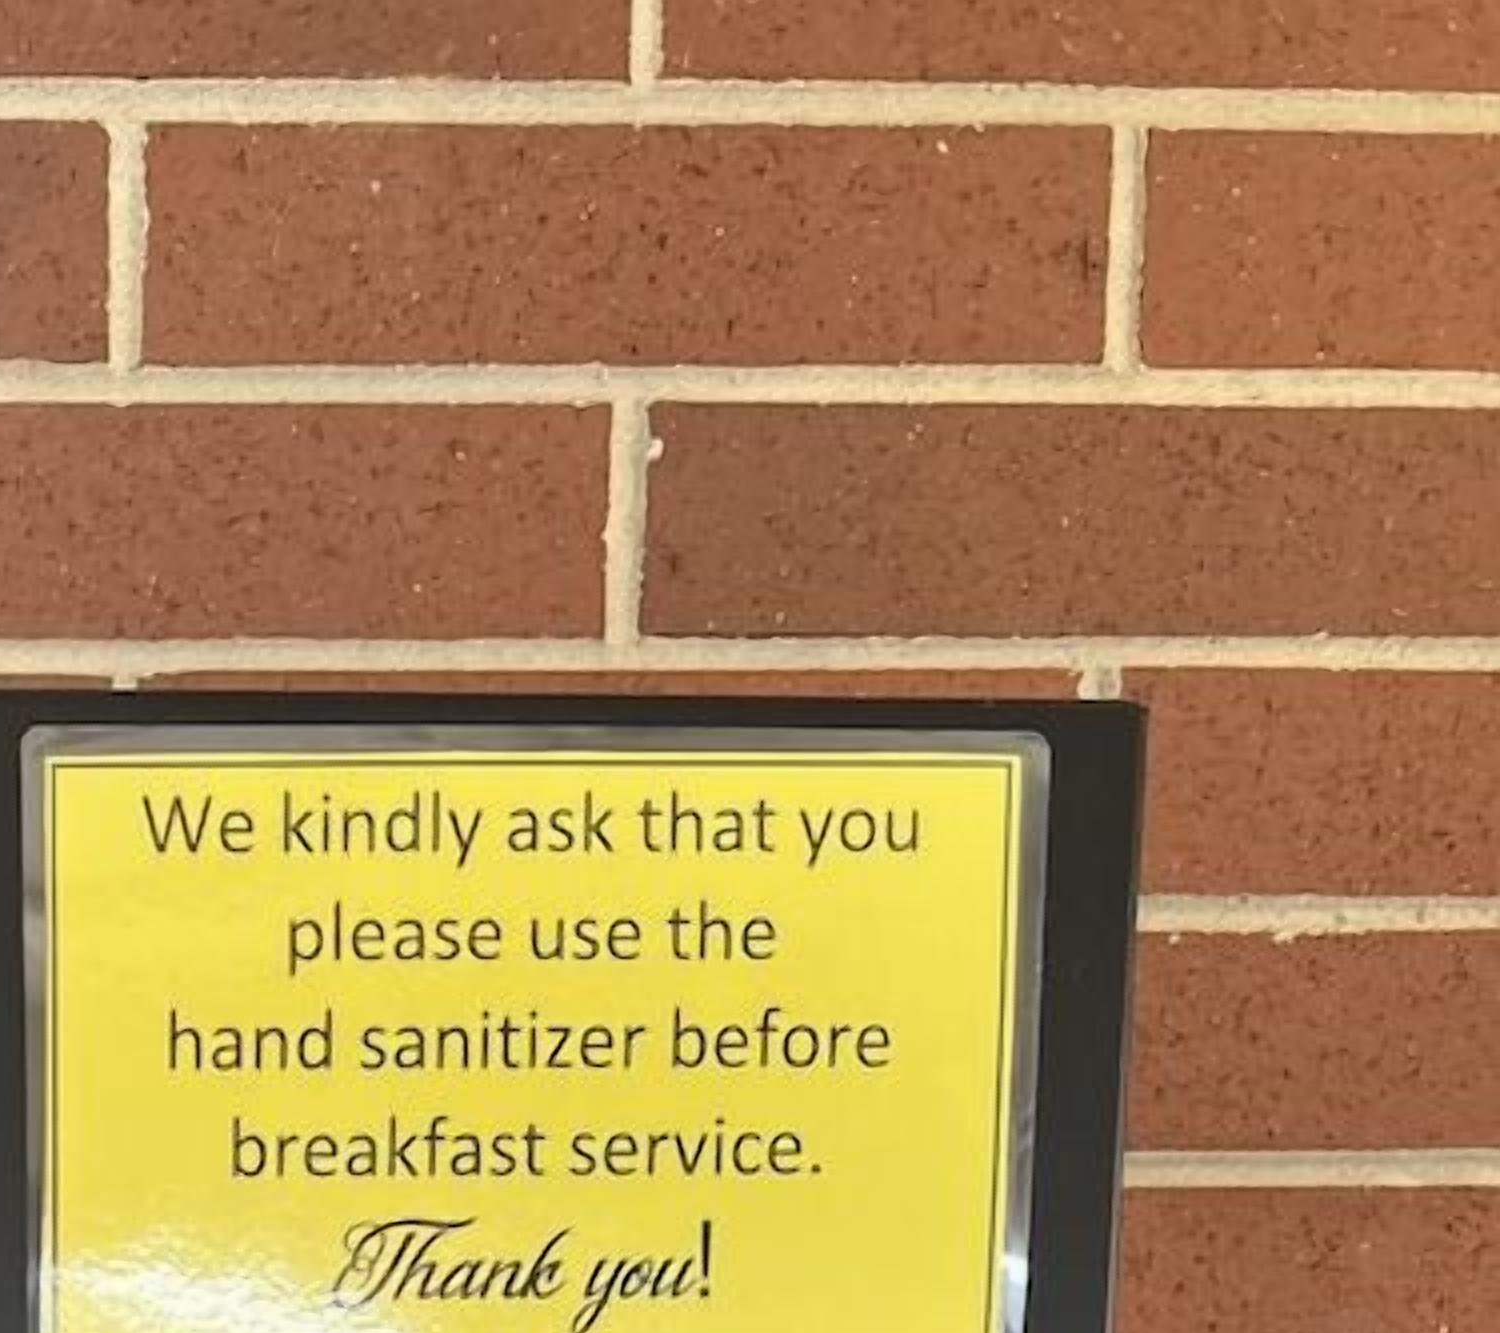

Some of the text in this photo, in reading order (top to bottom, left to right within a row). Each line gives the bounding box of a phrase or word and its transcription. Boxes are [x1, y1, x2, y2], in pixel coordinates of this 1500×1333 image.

[141, 790, 920, 868] We kindly ask that you
[287, 900, 777, 976] please use the
[168, 1007, 891, 1071] hand sanitizer before
[232, 1115, 822, 1178] breakfast service.
[331, 1218, 569, 1303] Thank
